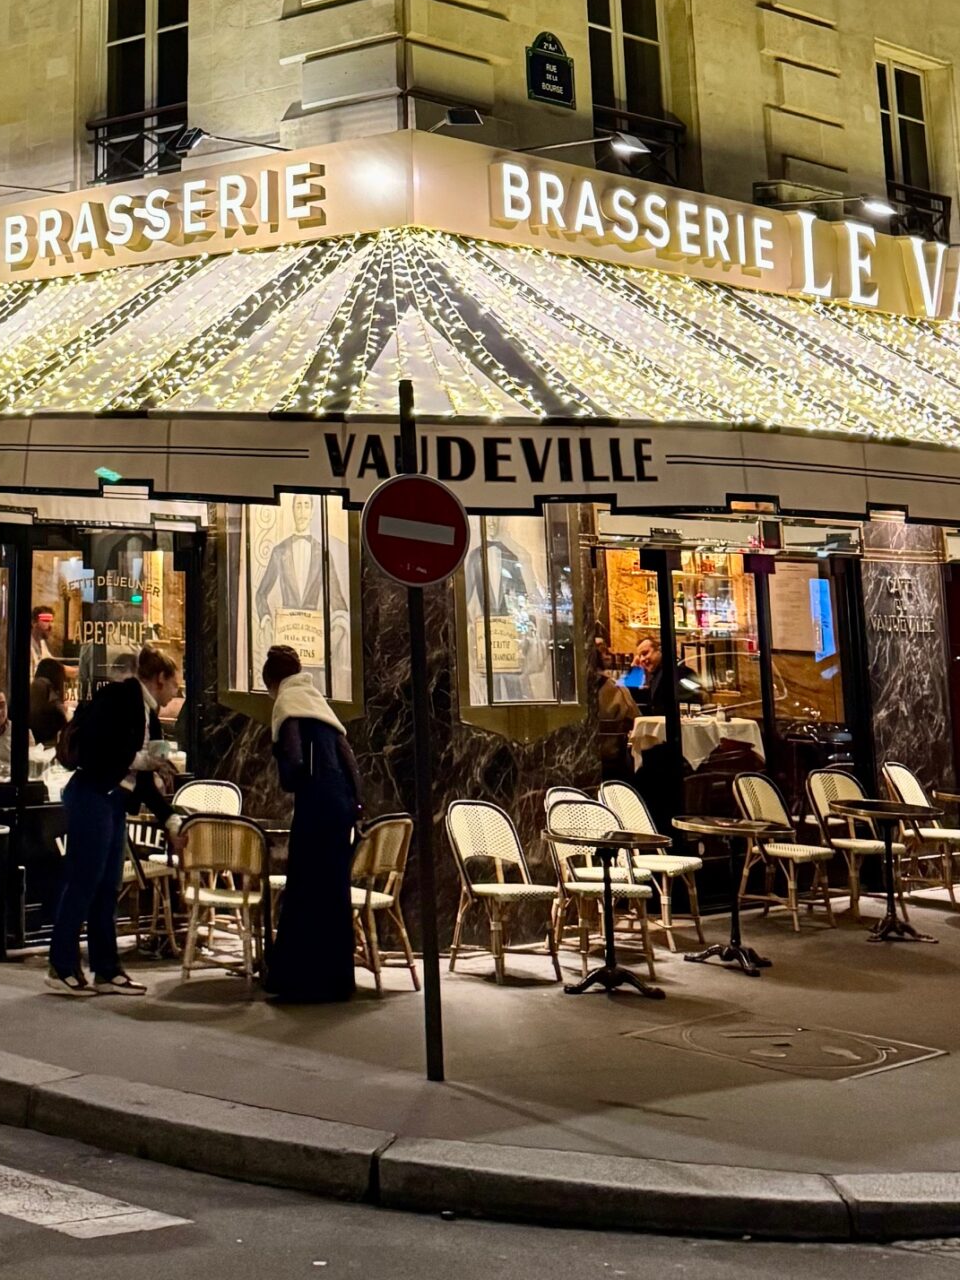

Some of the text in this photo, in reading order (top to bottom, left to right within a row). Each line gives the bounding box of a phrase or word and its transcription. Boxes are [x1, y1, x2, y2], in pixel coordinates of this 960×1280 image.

[546, 63, 557, 73] RUE
[542, 82, 563, 94] BOURSE
[4, 162, 312, 264] BRASSERIE
[501, 162, 960, 321] BRASSERIE LE V
[323, 432, 659, 483] VAUDEVILLE
[869, 614, 935, 633] VAUDEVILLE
[55, 823, 165, 857] VILLE
